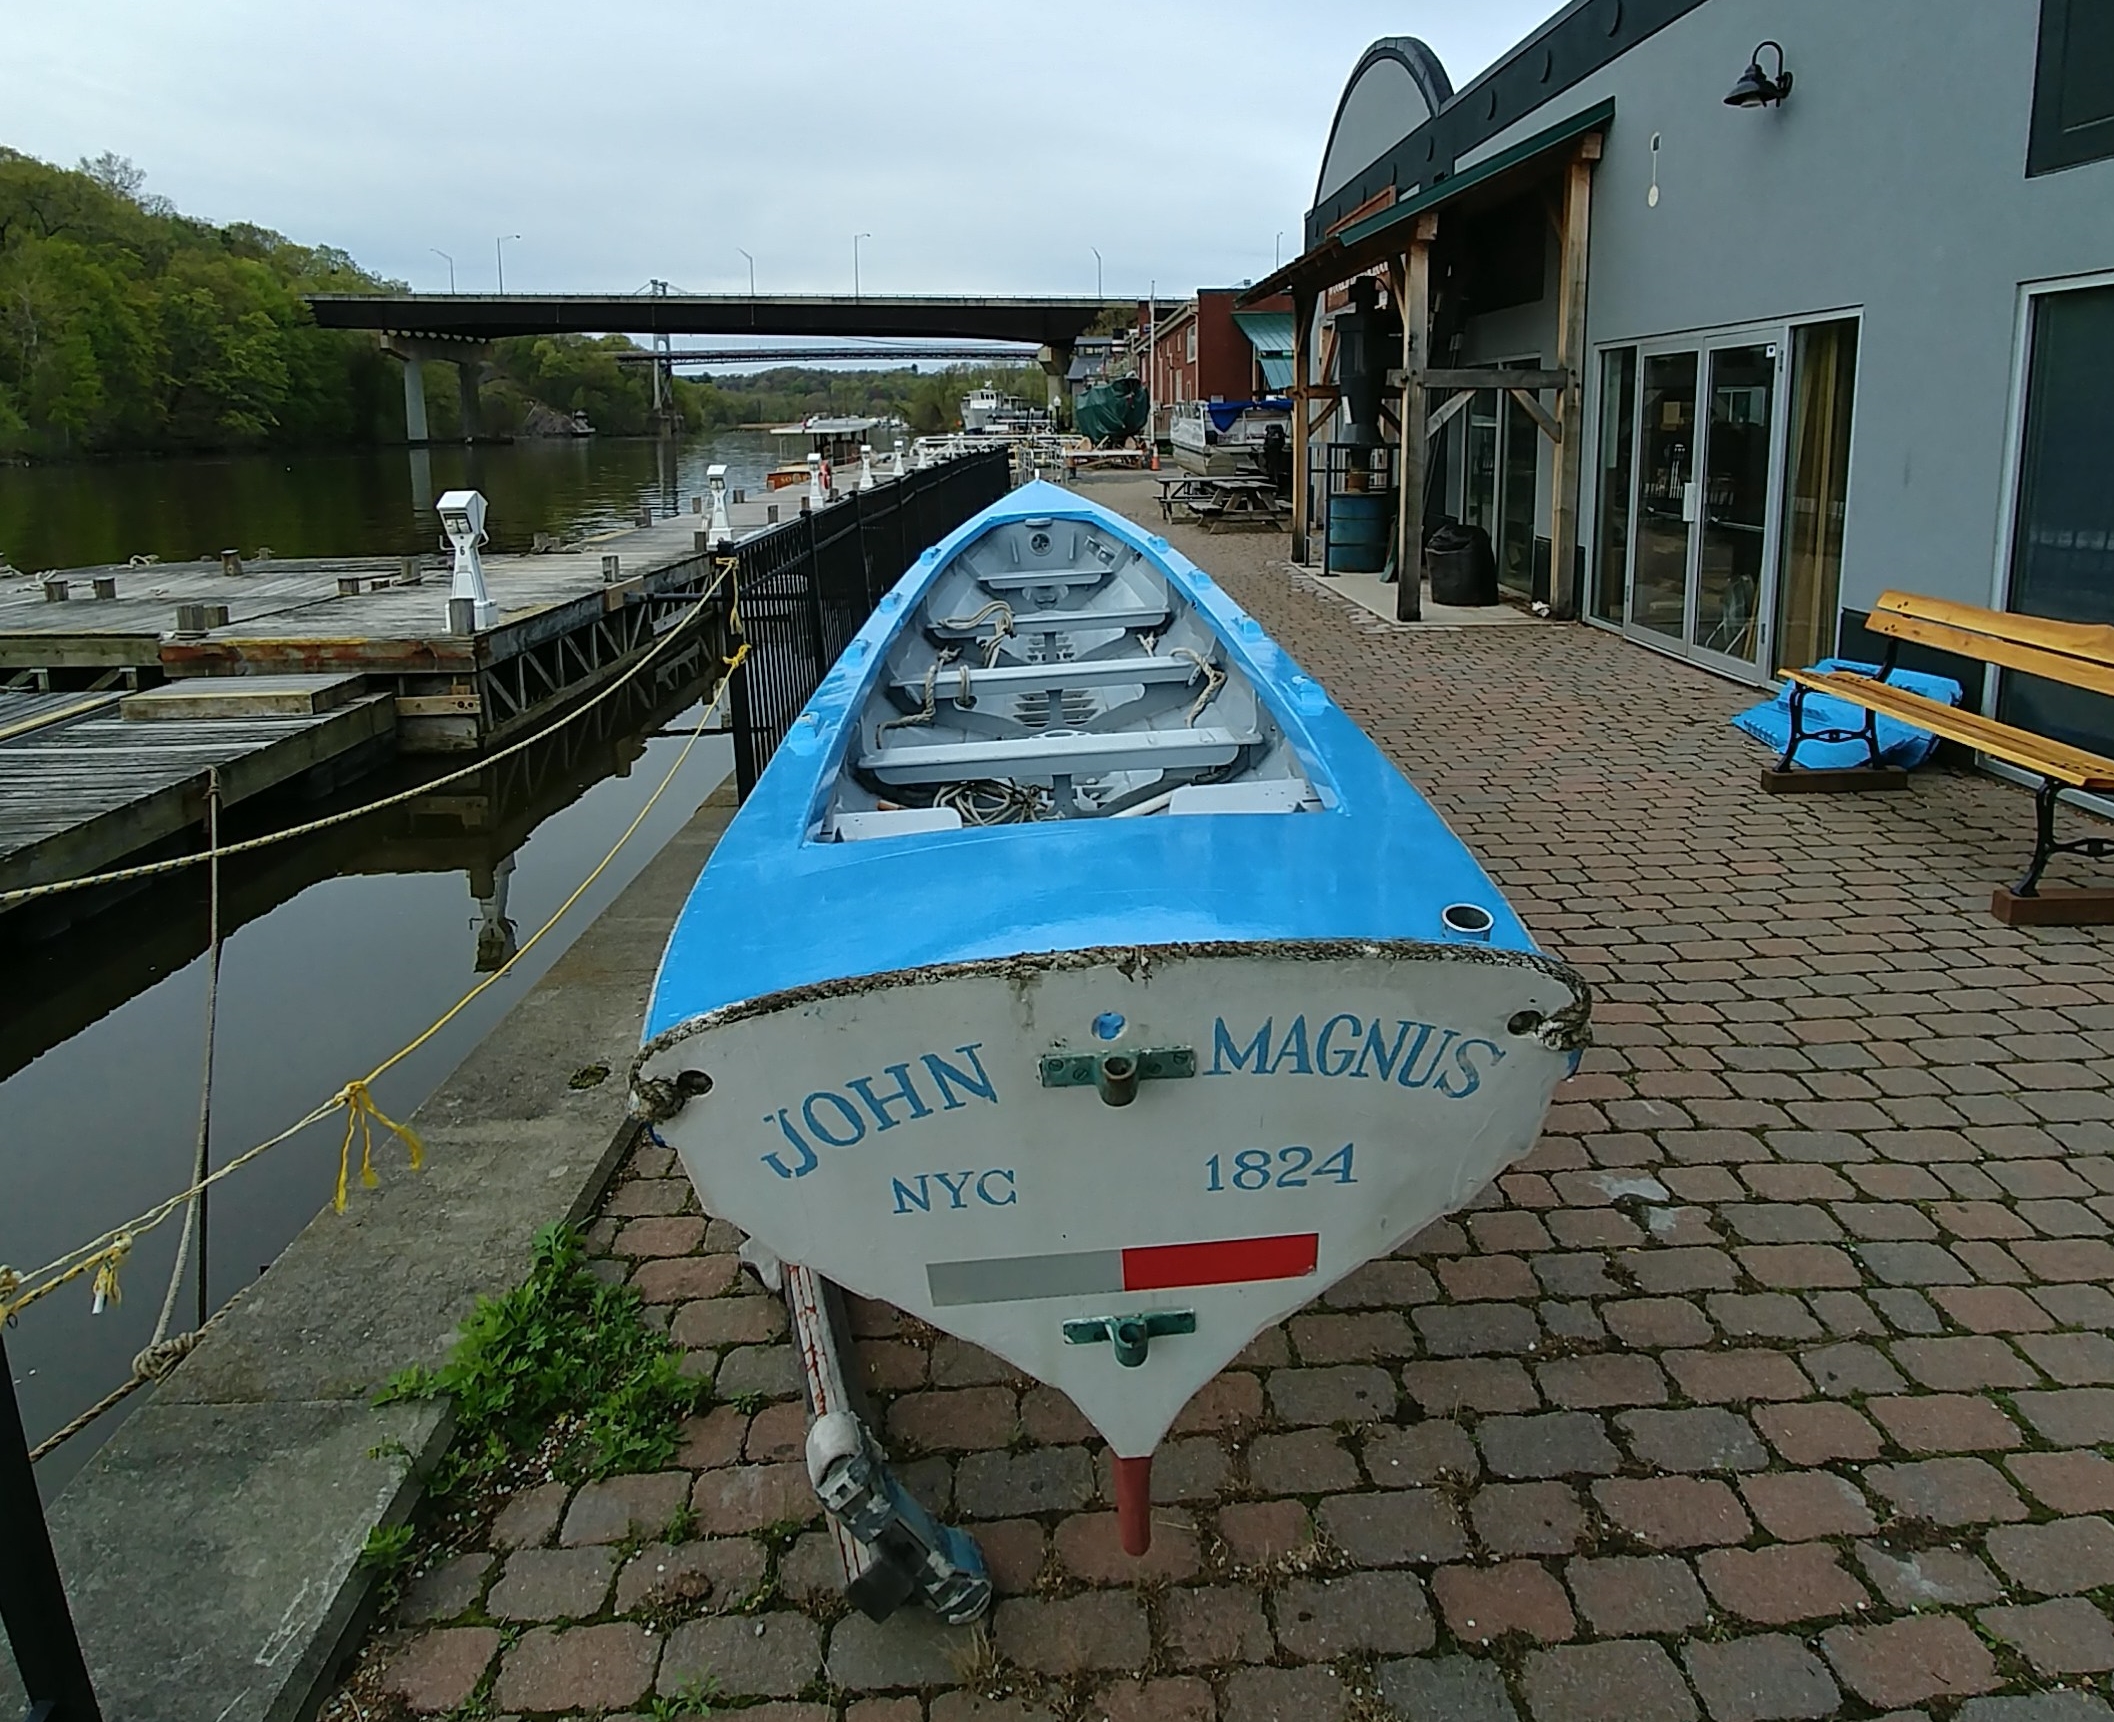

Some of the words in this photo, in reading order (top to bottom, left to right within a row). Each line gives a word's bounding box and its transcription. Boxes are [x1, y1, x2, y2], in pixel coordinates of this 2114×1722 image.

[459, 545, 466, 556] 6
[761, 1043, 998, 1178] JOHN
[1203, 1014, 1506, 1099] MAGNUS
[1206, 1143, 1358, 1192] 1824
[892, 1169, 1016, 1214] NYC
